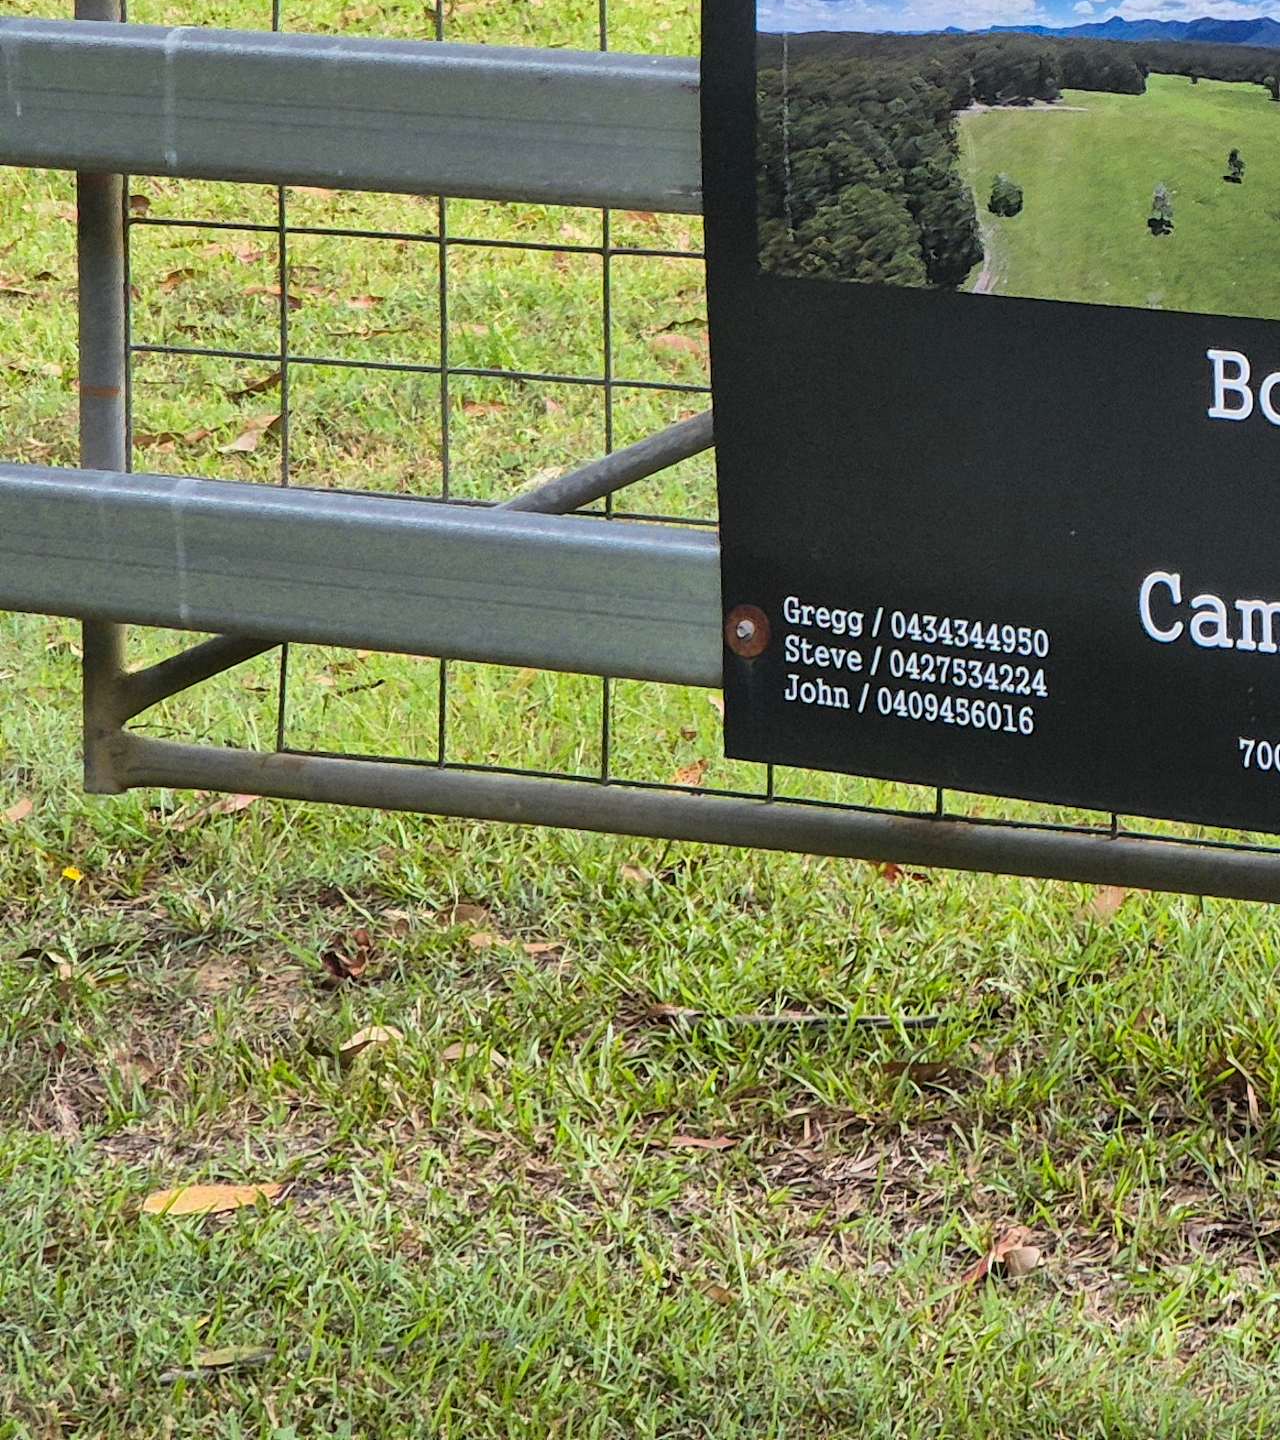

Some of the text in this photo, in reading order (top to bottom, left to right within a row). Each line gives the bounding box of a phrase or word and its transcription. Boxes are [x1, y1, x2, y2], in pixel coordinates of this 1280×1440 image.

[782, 596, 1050, 658] Gregg / 0434344950
[783, 634, 1049, 698] Steve / 0427534224
[783, 673, 1035, 736] John / 0409456016
